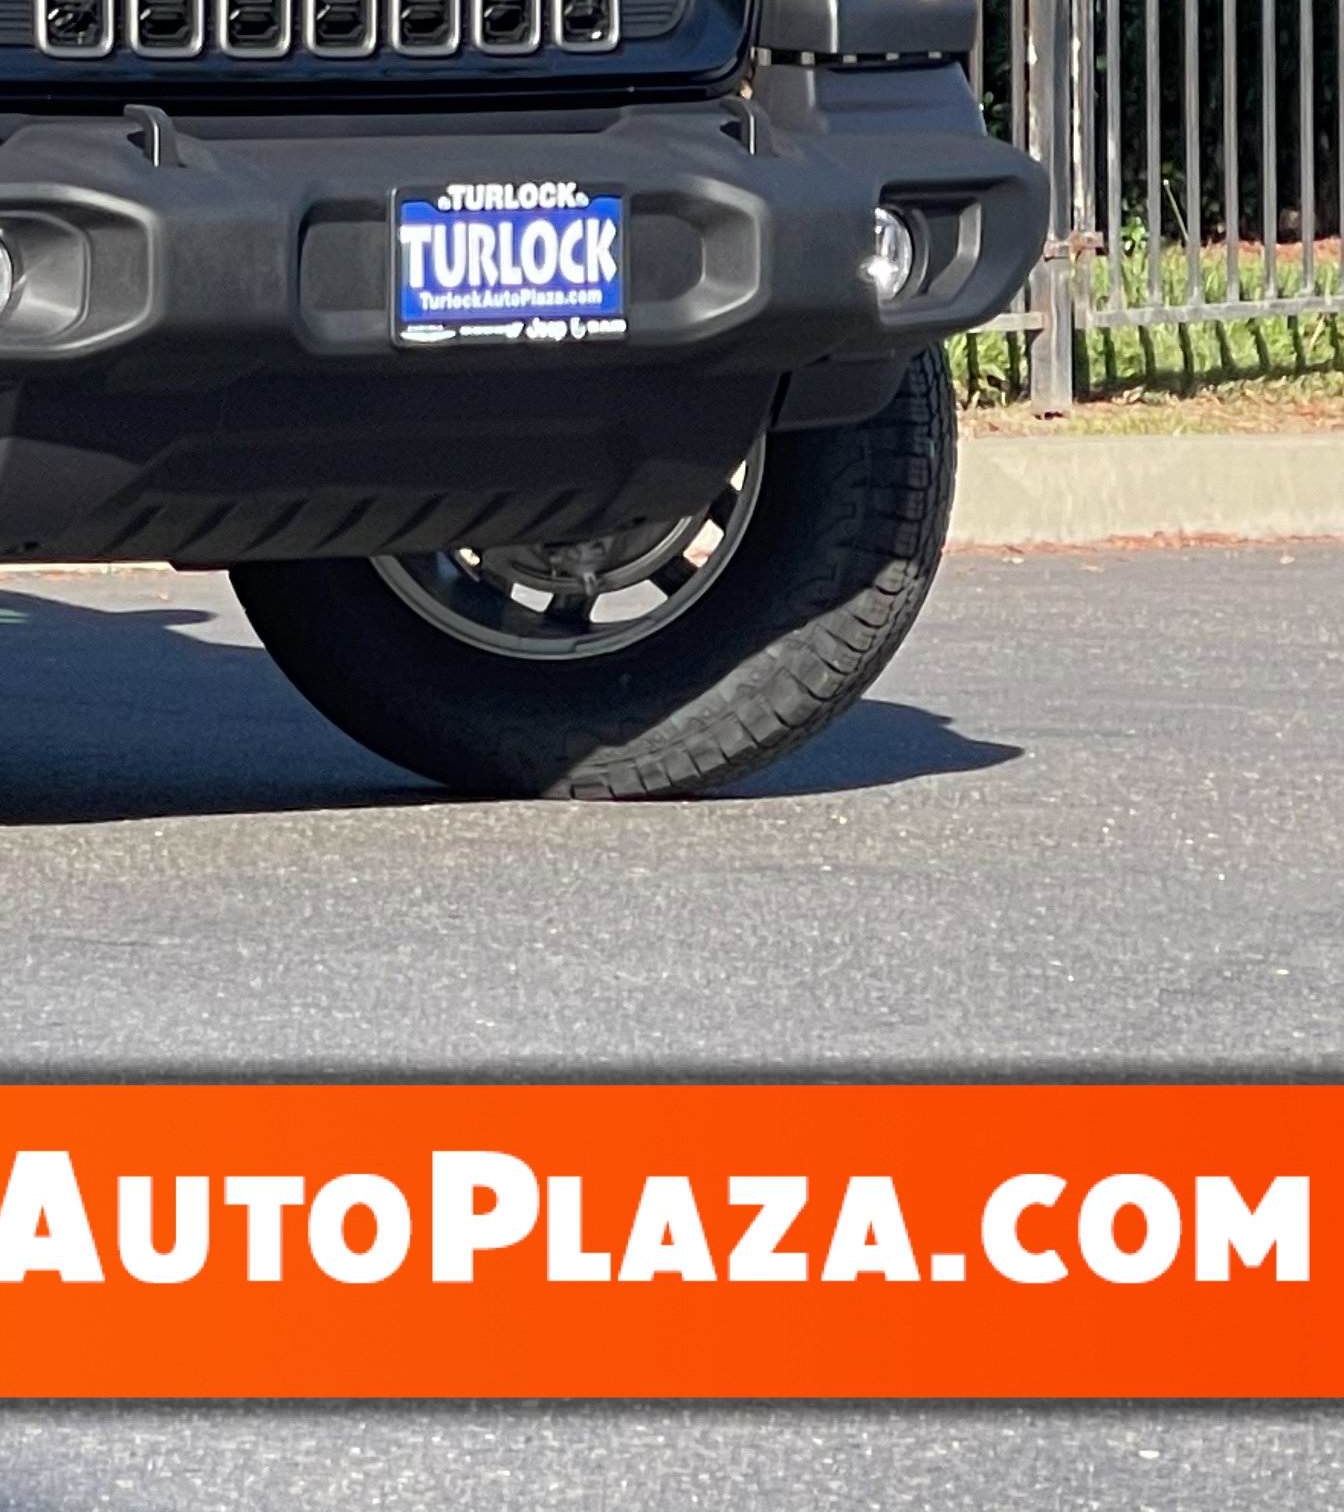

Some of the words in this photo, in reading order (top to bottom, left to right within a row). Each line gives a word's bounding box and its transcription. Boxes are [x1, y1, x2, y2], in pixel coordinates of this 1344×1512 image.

[446, 182, 577, 211] TURLOCK
[399, 218, 618, 289] TURLOCK
[420, 288, 603, 311] TurlockAutoPlaza.com
